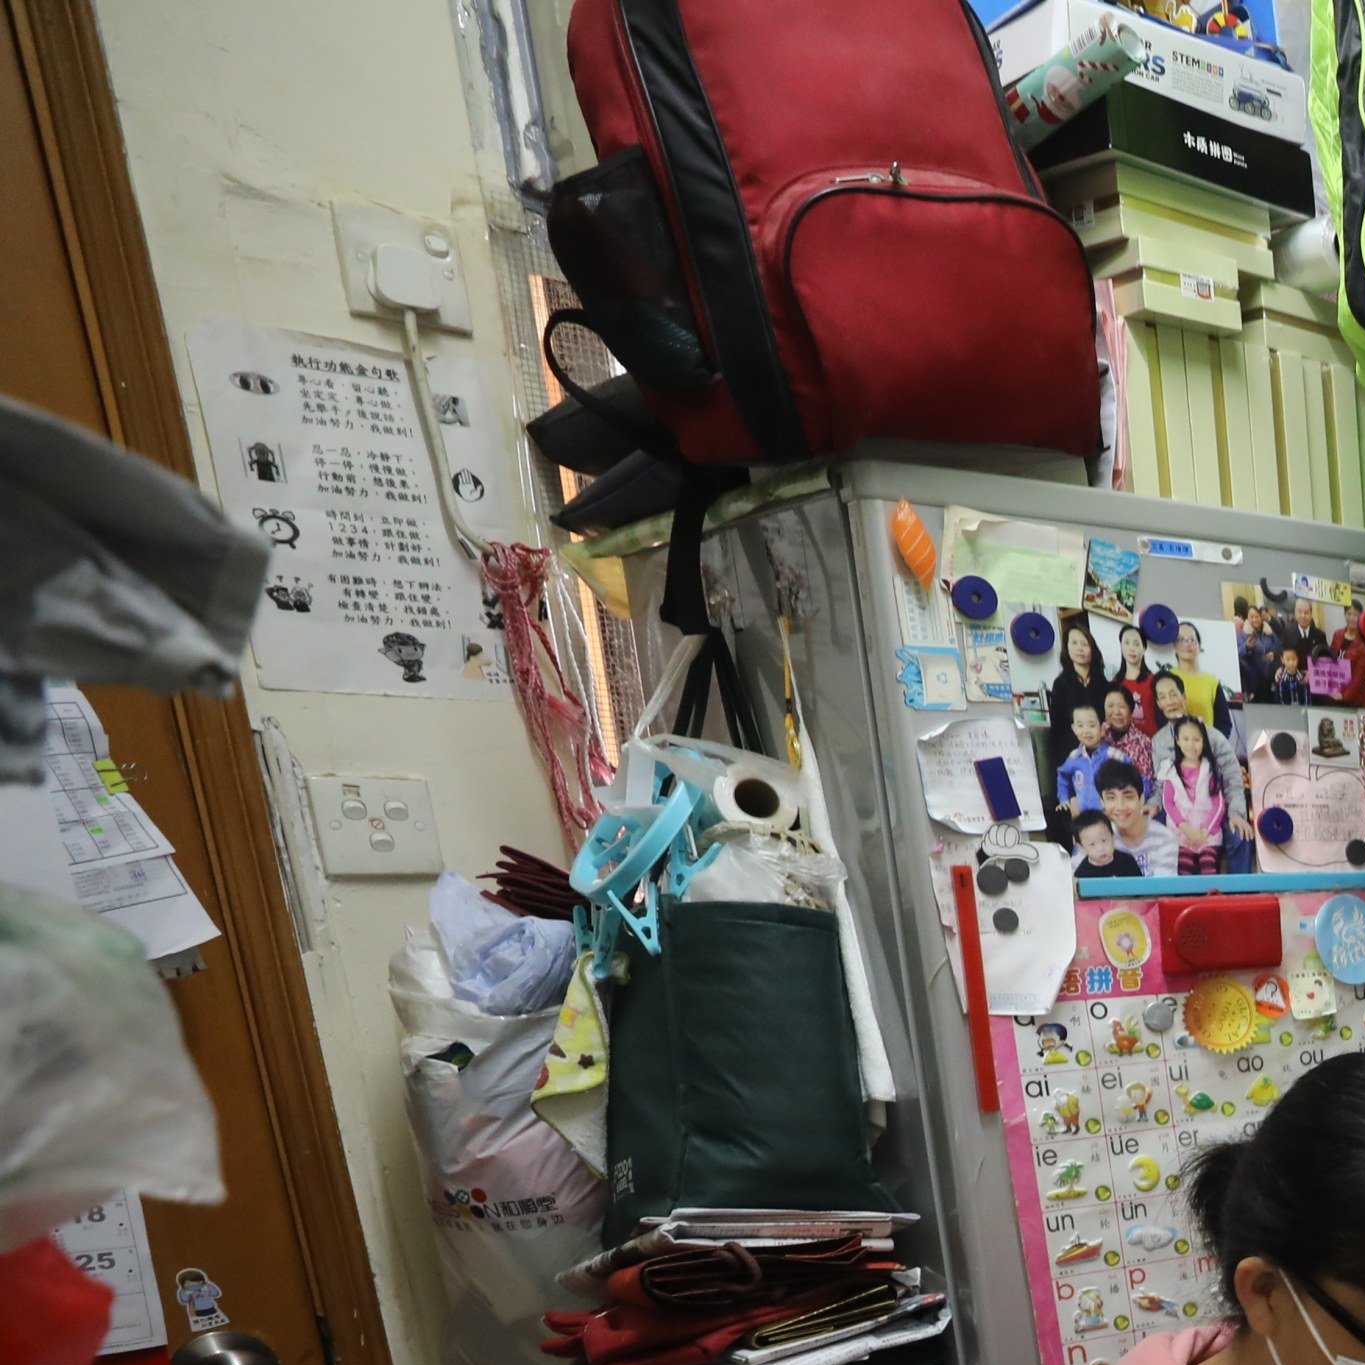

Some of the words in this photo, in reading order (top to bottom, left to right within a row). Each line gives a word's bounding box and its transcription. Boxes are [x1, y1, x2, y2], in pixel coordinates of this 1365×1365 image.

[1172, 50, 1201, 70] STEM
[1183, 131, 1233, 163] 木质拼图
[291, 354, 400, 382] 執行功能金句歌
[1025, 1074, 1051, 1098] ai
[1101, 1067, 1123, 1090] ei
[1169, 1060, 1189, 1082] ui
[1237, 1054, 1264, 1073] ao
[1035, 1146, 1058, 1167] ie
[1110, 1135, 1139, 1156] üe
[501, 1194, 559, 1219] 和順堂
[1046, 1213, 1075, 1233] un
[1121, 1201, 1147, 1221] ün
[75, 1252, 116, 1272] 25
[1056, 1280, 1074, 1301] b
[1129, 1267, 1146, 1289] p
[1067, 1343, 1087, 1365] n
